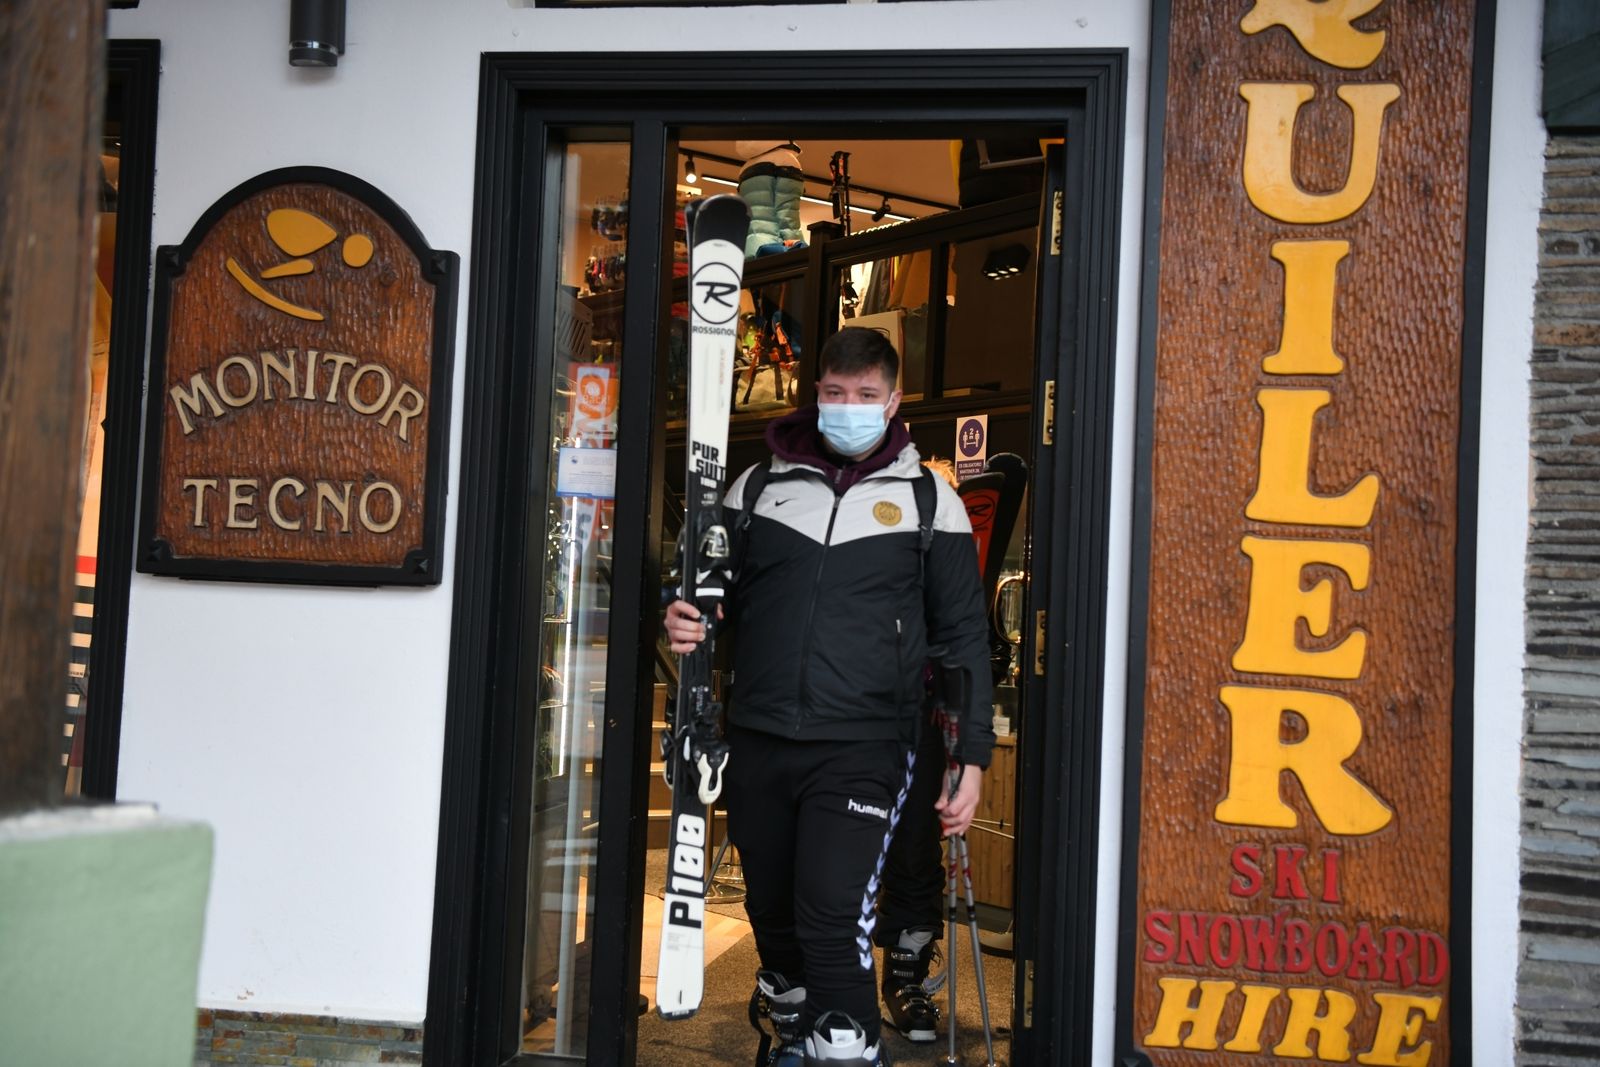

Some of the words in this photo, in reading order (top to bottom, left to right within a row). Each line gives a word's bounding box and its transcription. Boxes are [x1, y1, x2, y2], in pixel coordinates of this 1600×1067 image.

[695, 281, 738, 308] R
[692, 325, 736, 336] ROSSIGNOL
[169, 349, 425, 442] MONITOR
[692, 440, 719, 463] PUR
[183, 477, 402, 533] TECNO
[847, 798, 889, 820] hummel
[668, 812, 706, 929] P100
[1229, 844, 1340, 905] SKI
[1143, 911, 1448, 987] SNOWBOARD
[1143, 977, 1442, 1067] HIRE
